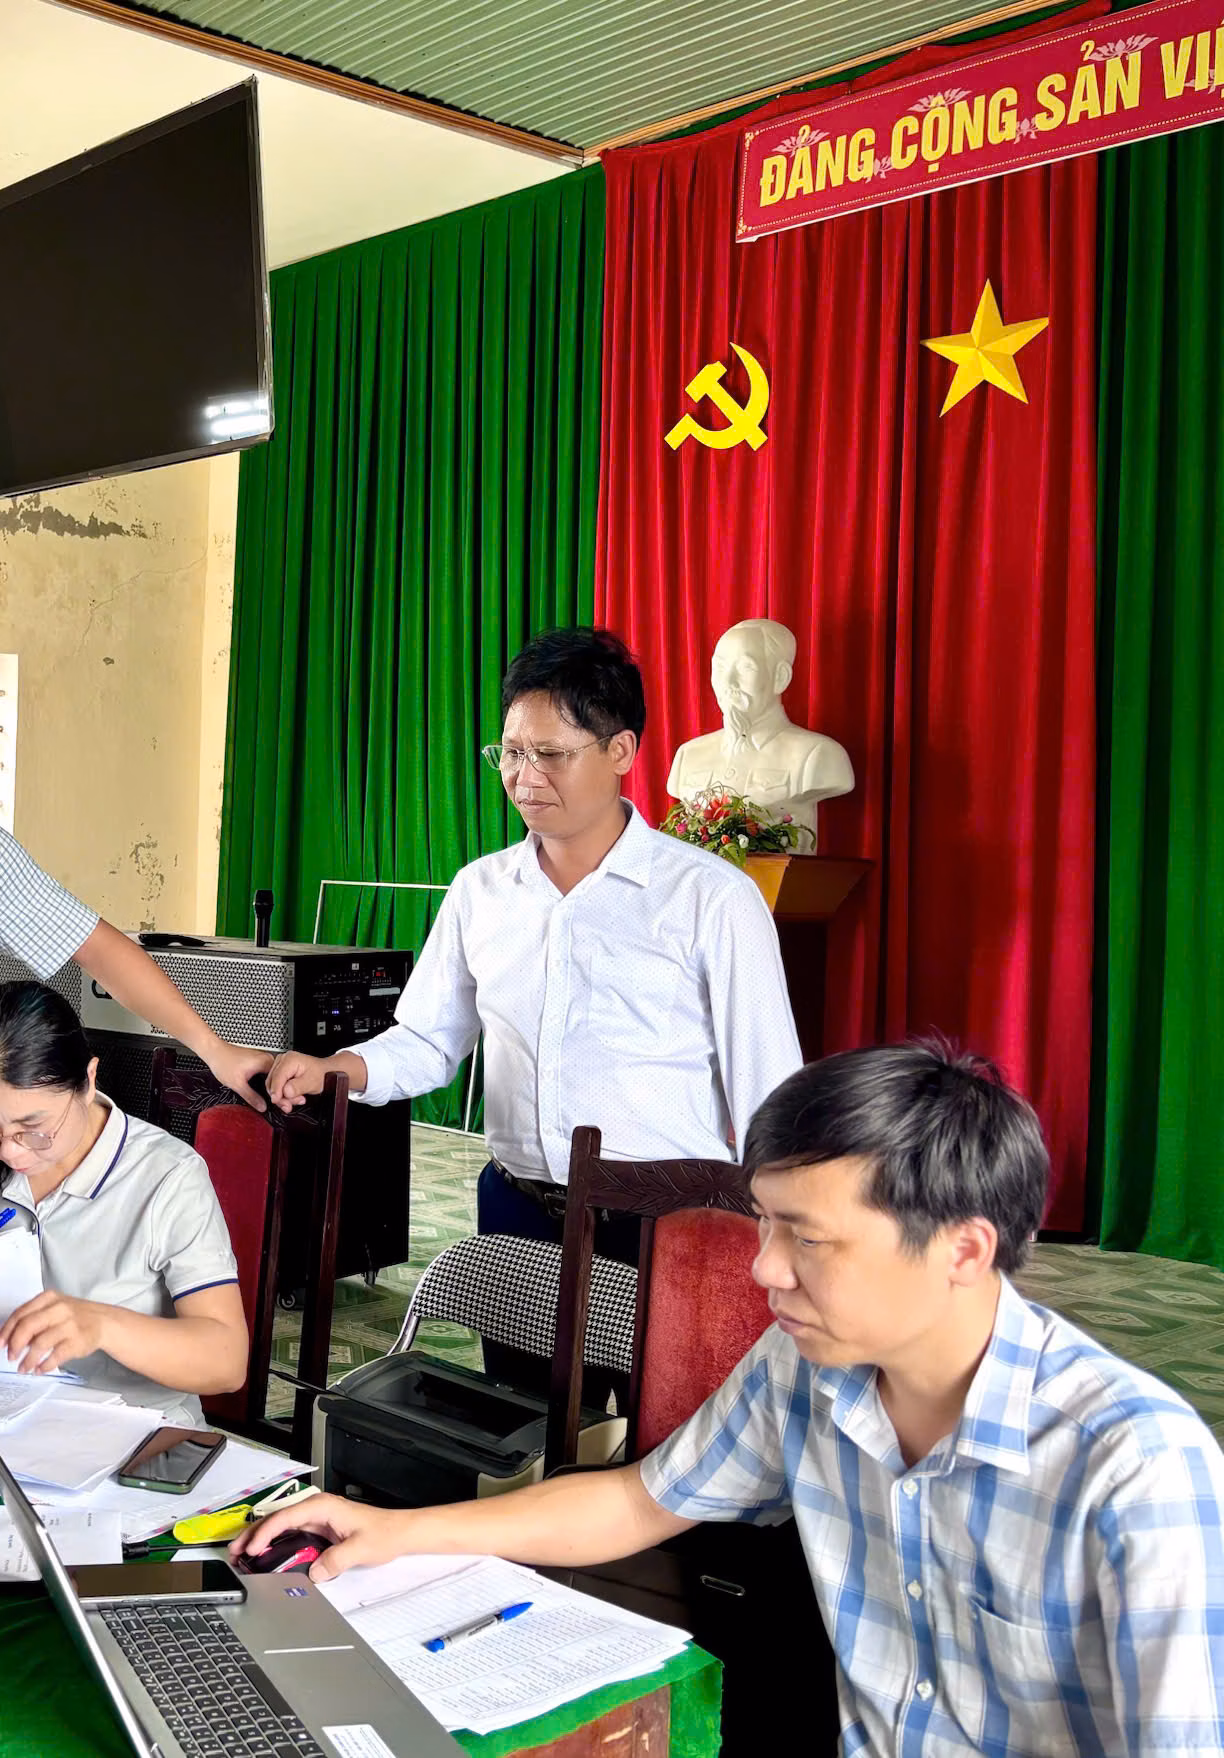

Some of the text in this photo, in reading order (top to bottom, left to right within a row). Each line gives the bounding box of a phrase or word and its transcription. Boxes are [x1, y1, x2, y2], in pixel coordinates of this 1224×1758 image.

[758, 18, 1224, 207] ĐẢNG CỘNG SẢN VI
